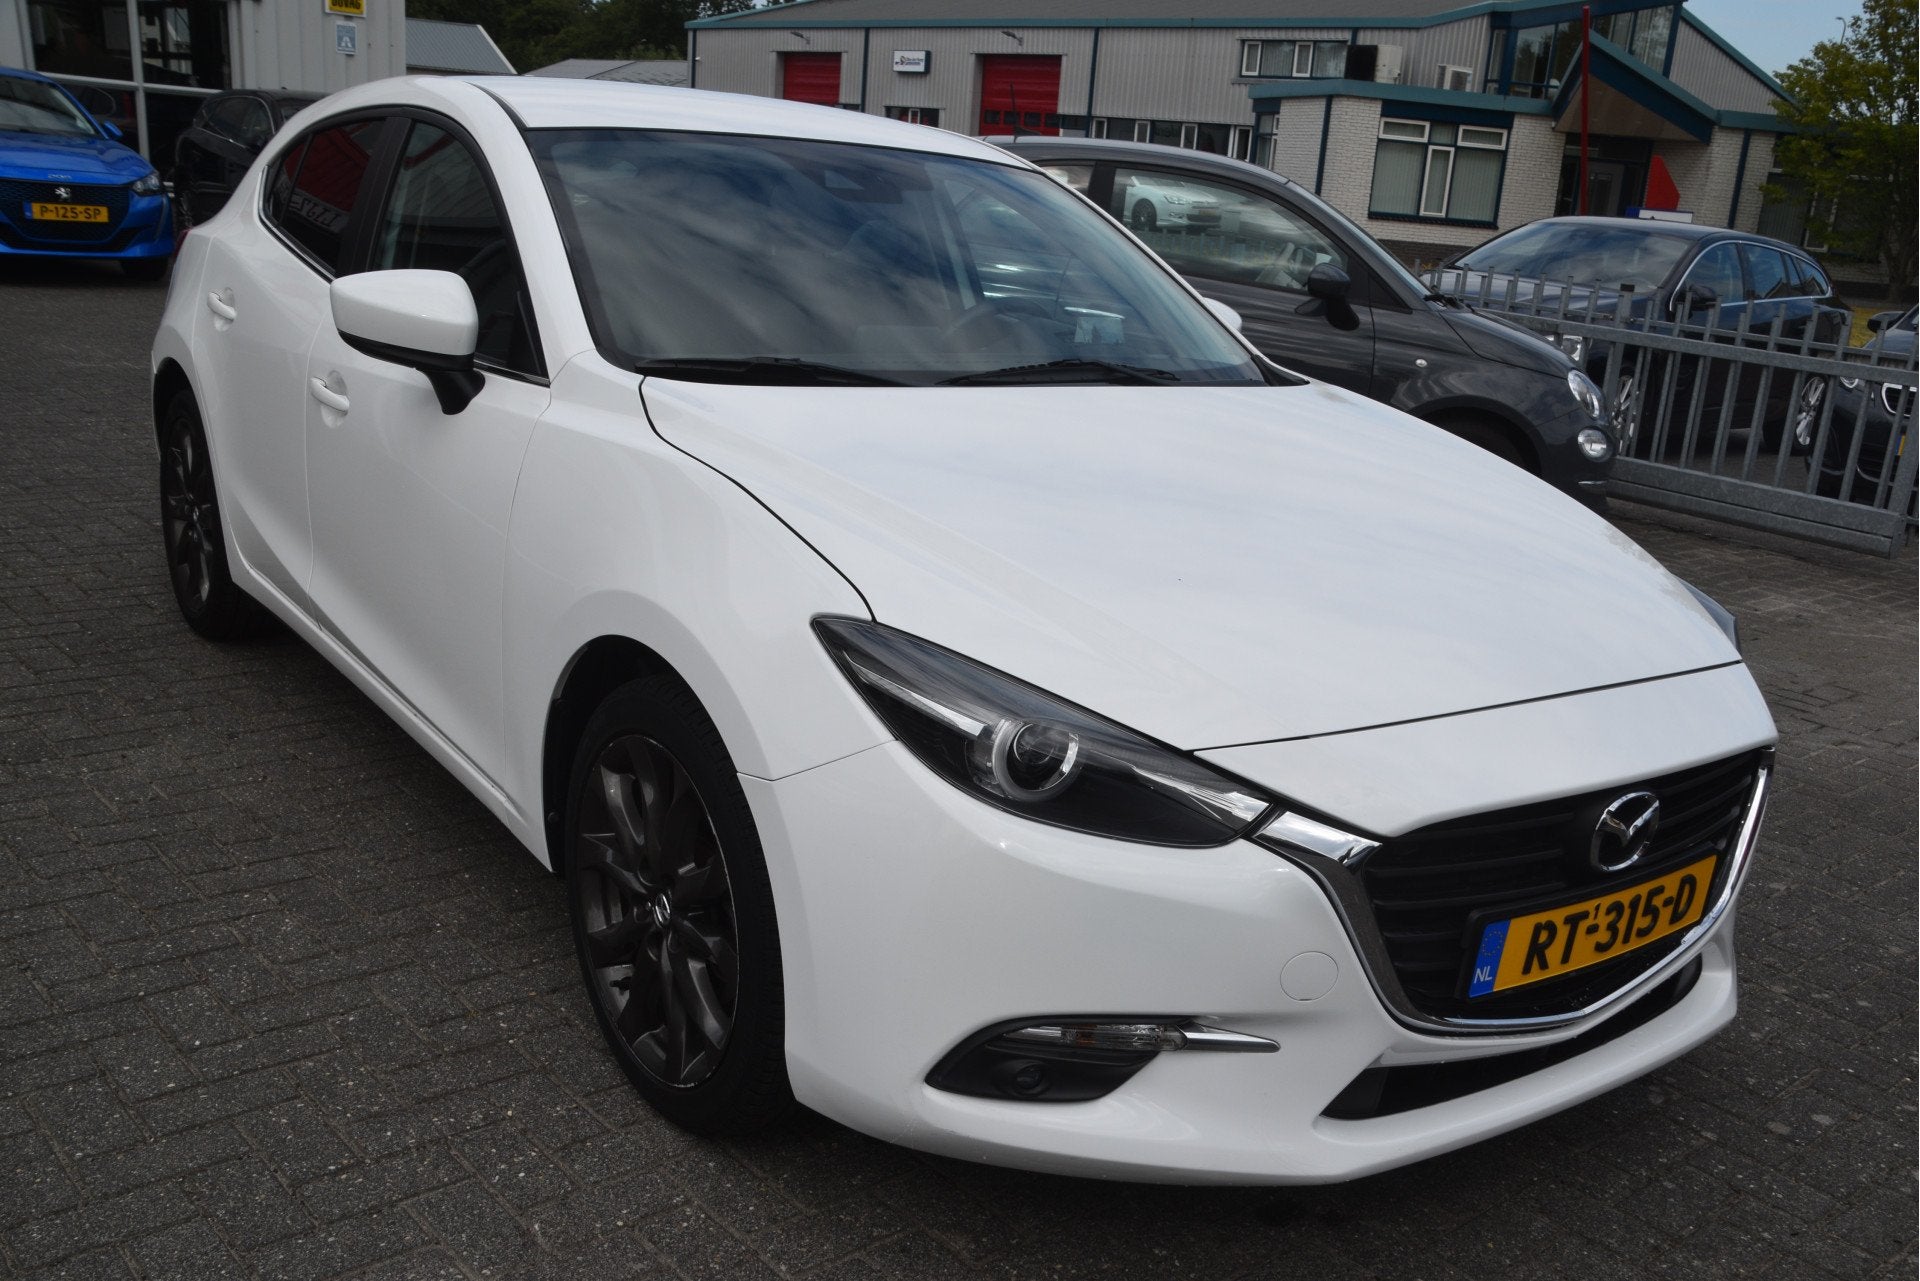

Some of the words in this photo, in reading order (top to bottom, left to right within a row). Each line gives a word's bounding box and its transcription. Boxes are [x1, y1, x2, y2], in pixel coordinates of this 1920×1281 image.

[40, 205, 101, 220] P-125-SP
[1521, 873, 1698, 976] RT-315-D
[1473, 967, 1493, 984] NL
